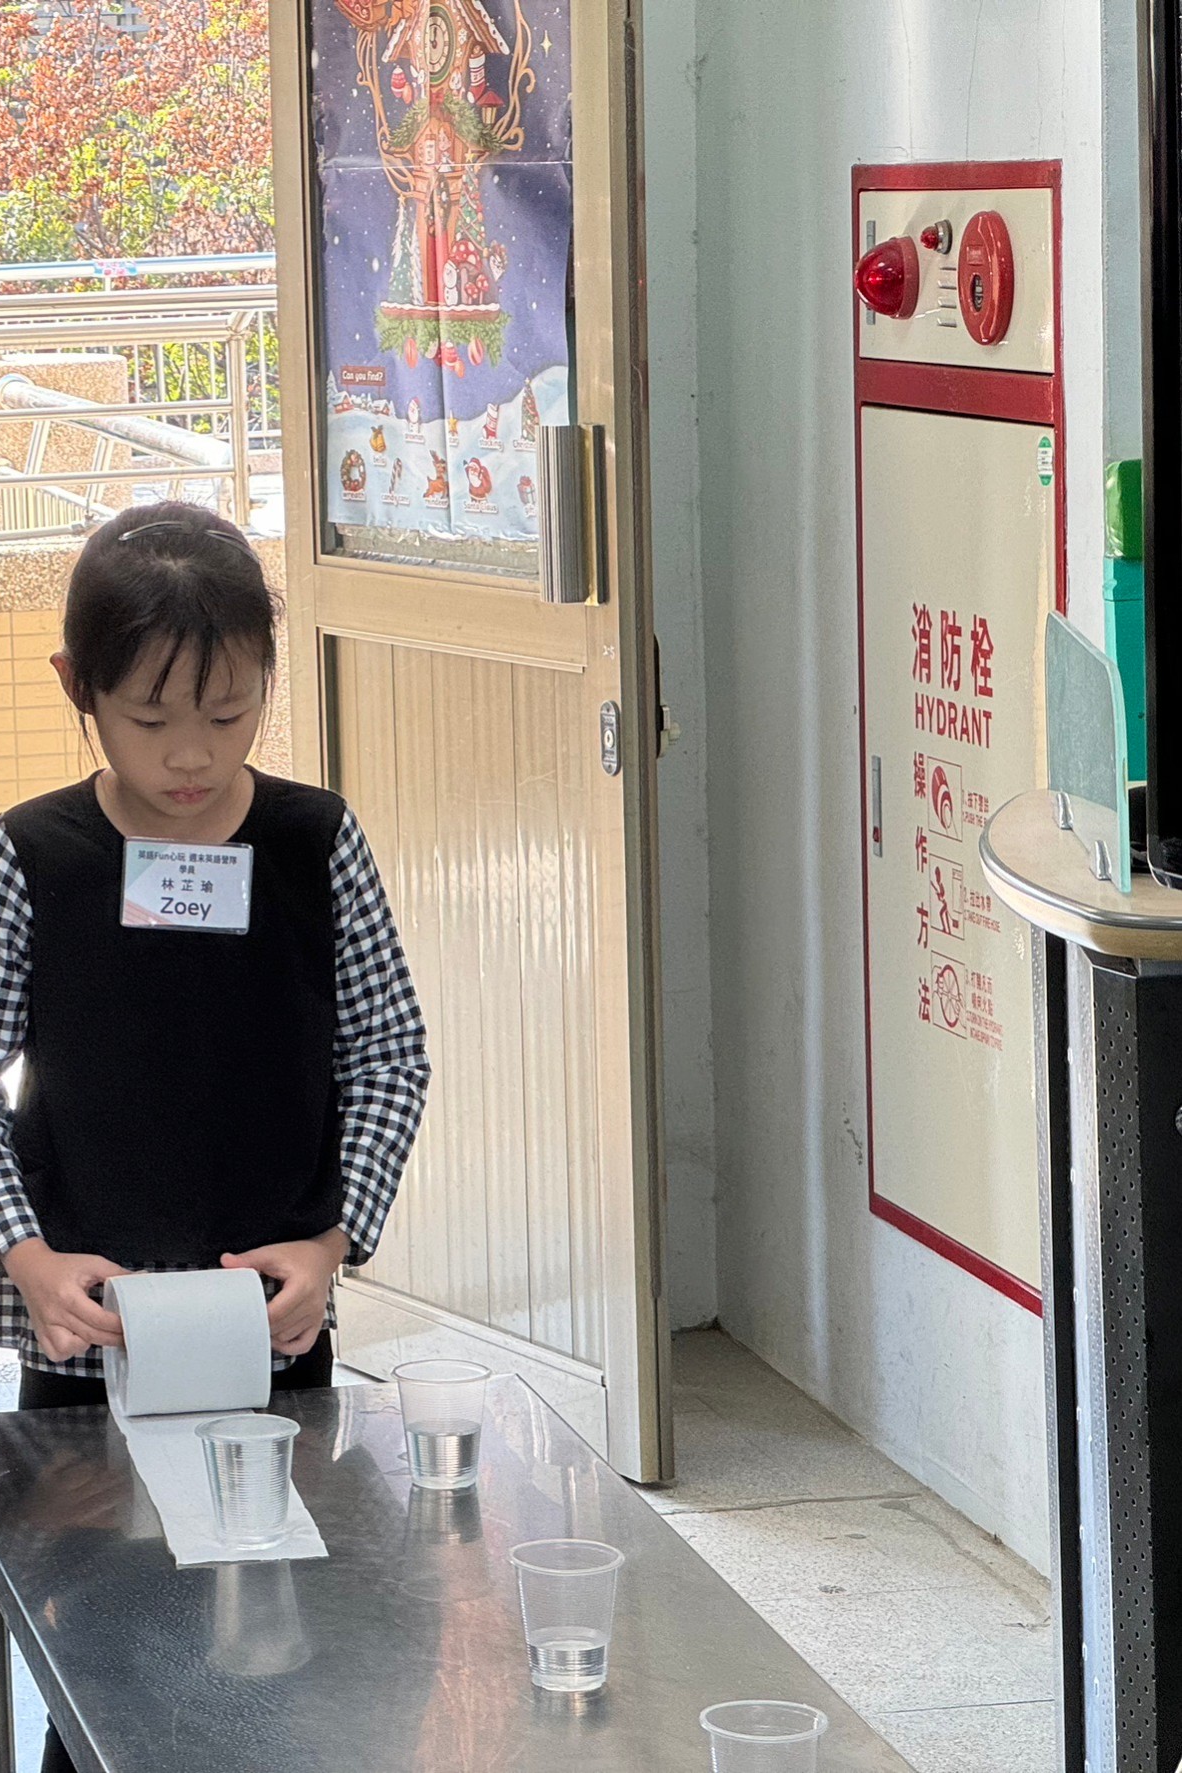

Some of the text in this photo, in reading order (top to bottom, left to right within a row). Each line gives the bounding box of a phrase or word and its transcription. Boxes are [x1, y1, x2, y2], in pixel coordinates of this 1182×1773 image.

[342, 370, 354, 380] Can
[355, 372, 366, 382] you
[912, 601, 994, 698] 消防栓
[915, 692, 993, 749] HYDRANT
[160, 897, 212, 921] Zoey
